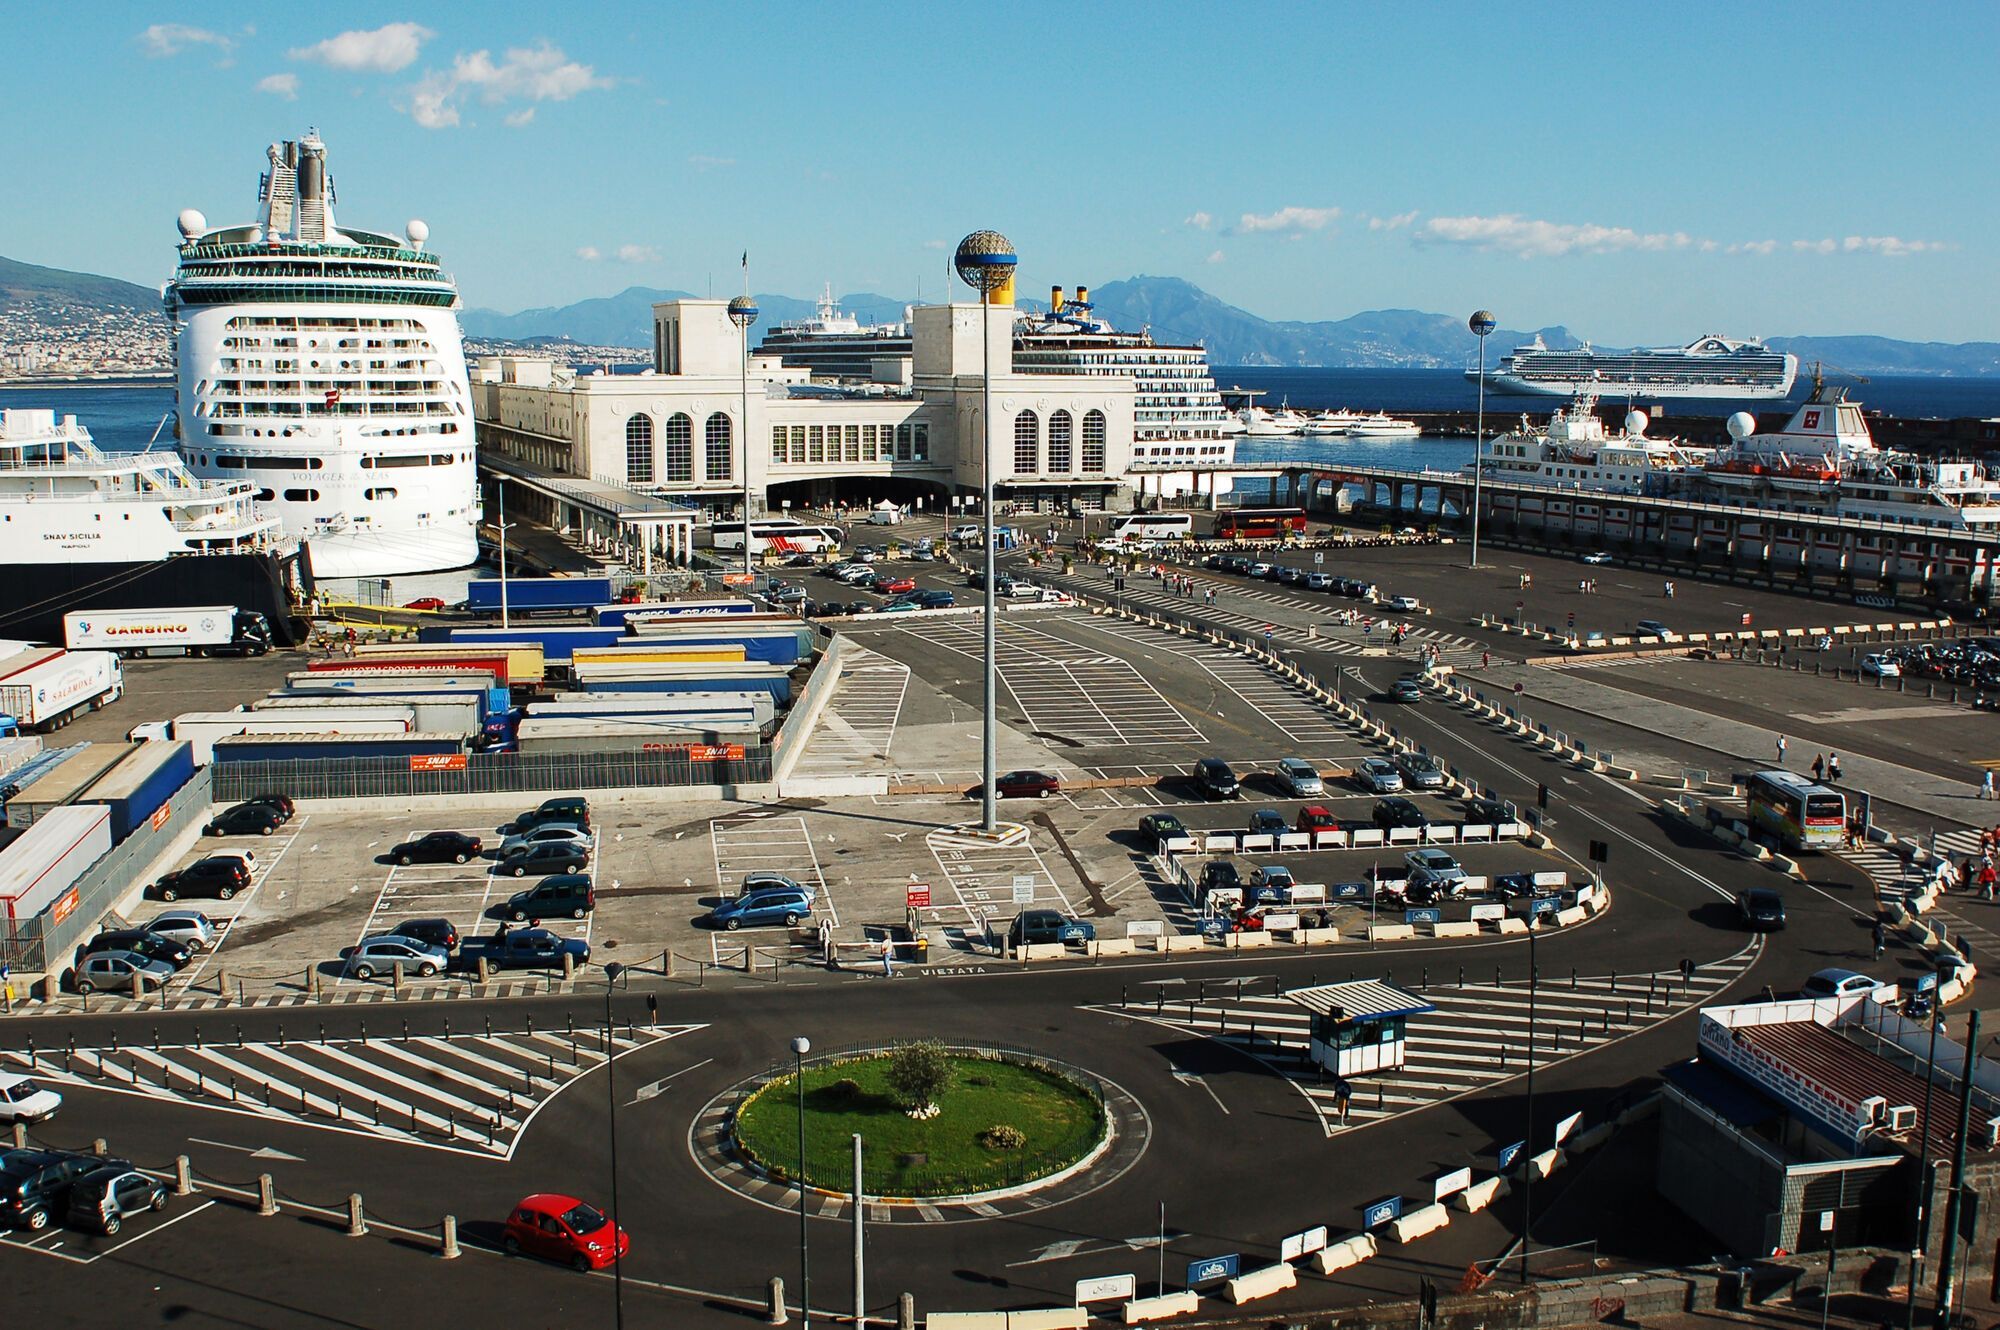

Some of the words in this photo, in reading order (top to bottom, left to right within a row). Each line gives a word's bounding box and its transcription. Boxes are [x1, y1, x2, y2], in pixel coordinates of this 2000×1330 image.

[292, 472, 345, 480] VOYAGER
[365, 472, 389, 480] SEAS
[105, 623, 188, 635] GAMBINO
[705, 748, 730, 756] SNAV
[426, 756, 452, 765] SNAV
[920, 966, 986, 976] VIETATA
